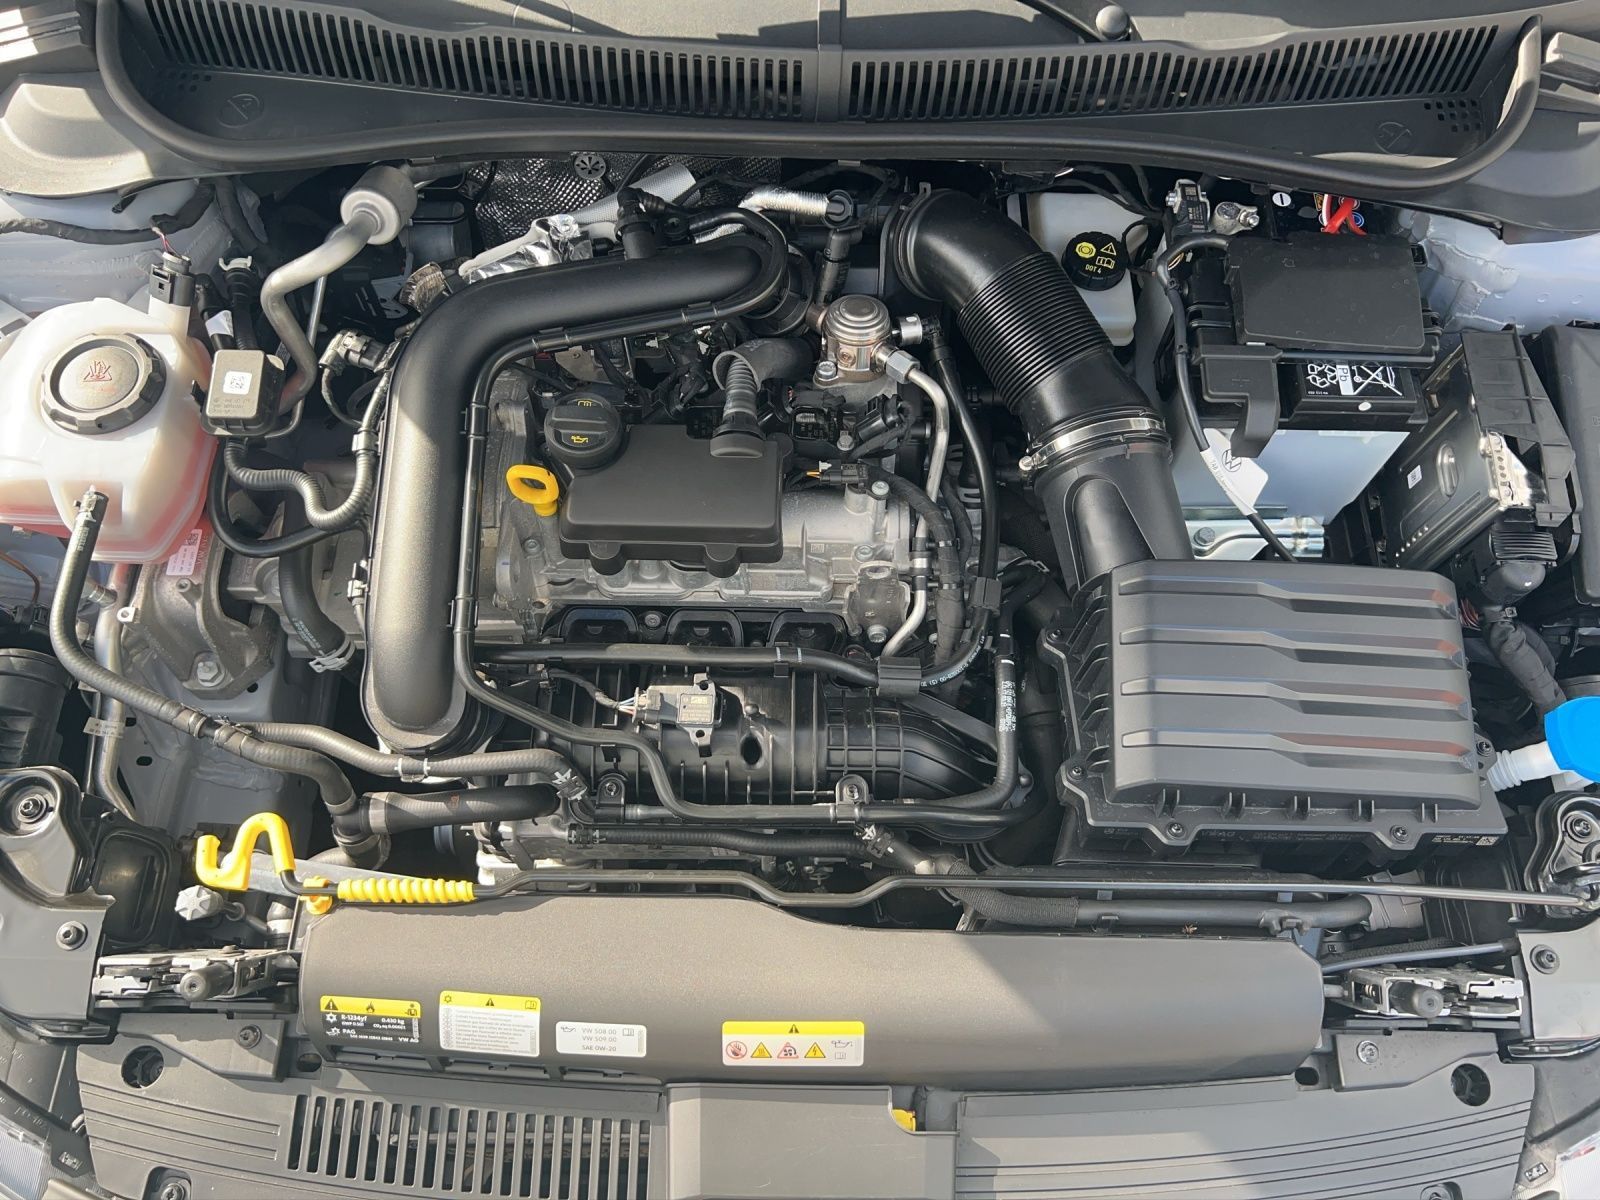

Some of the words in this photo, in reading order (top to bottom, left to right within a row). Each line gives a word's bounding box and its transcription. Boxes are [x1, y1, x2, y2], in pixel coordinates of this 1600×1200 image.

[1085, 263, 1098, 273] DOT
[1338, 367, 1349, 382] Pb
[341, 1014, 368, 1022] R-1234yf
